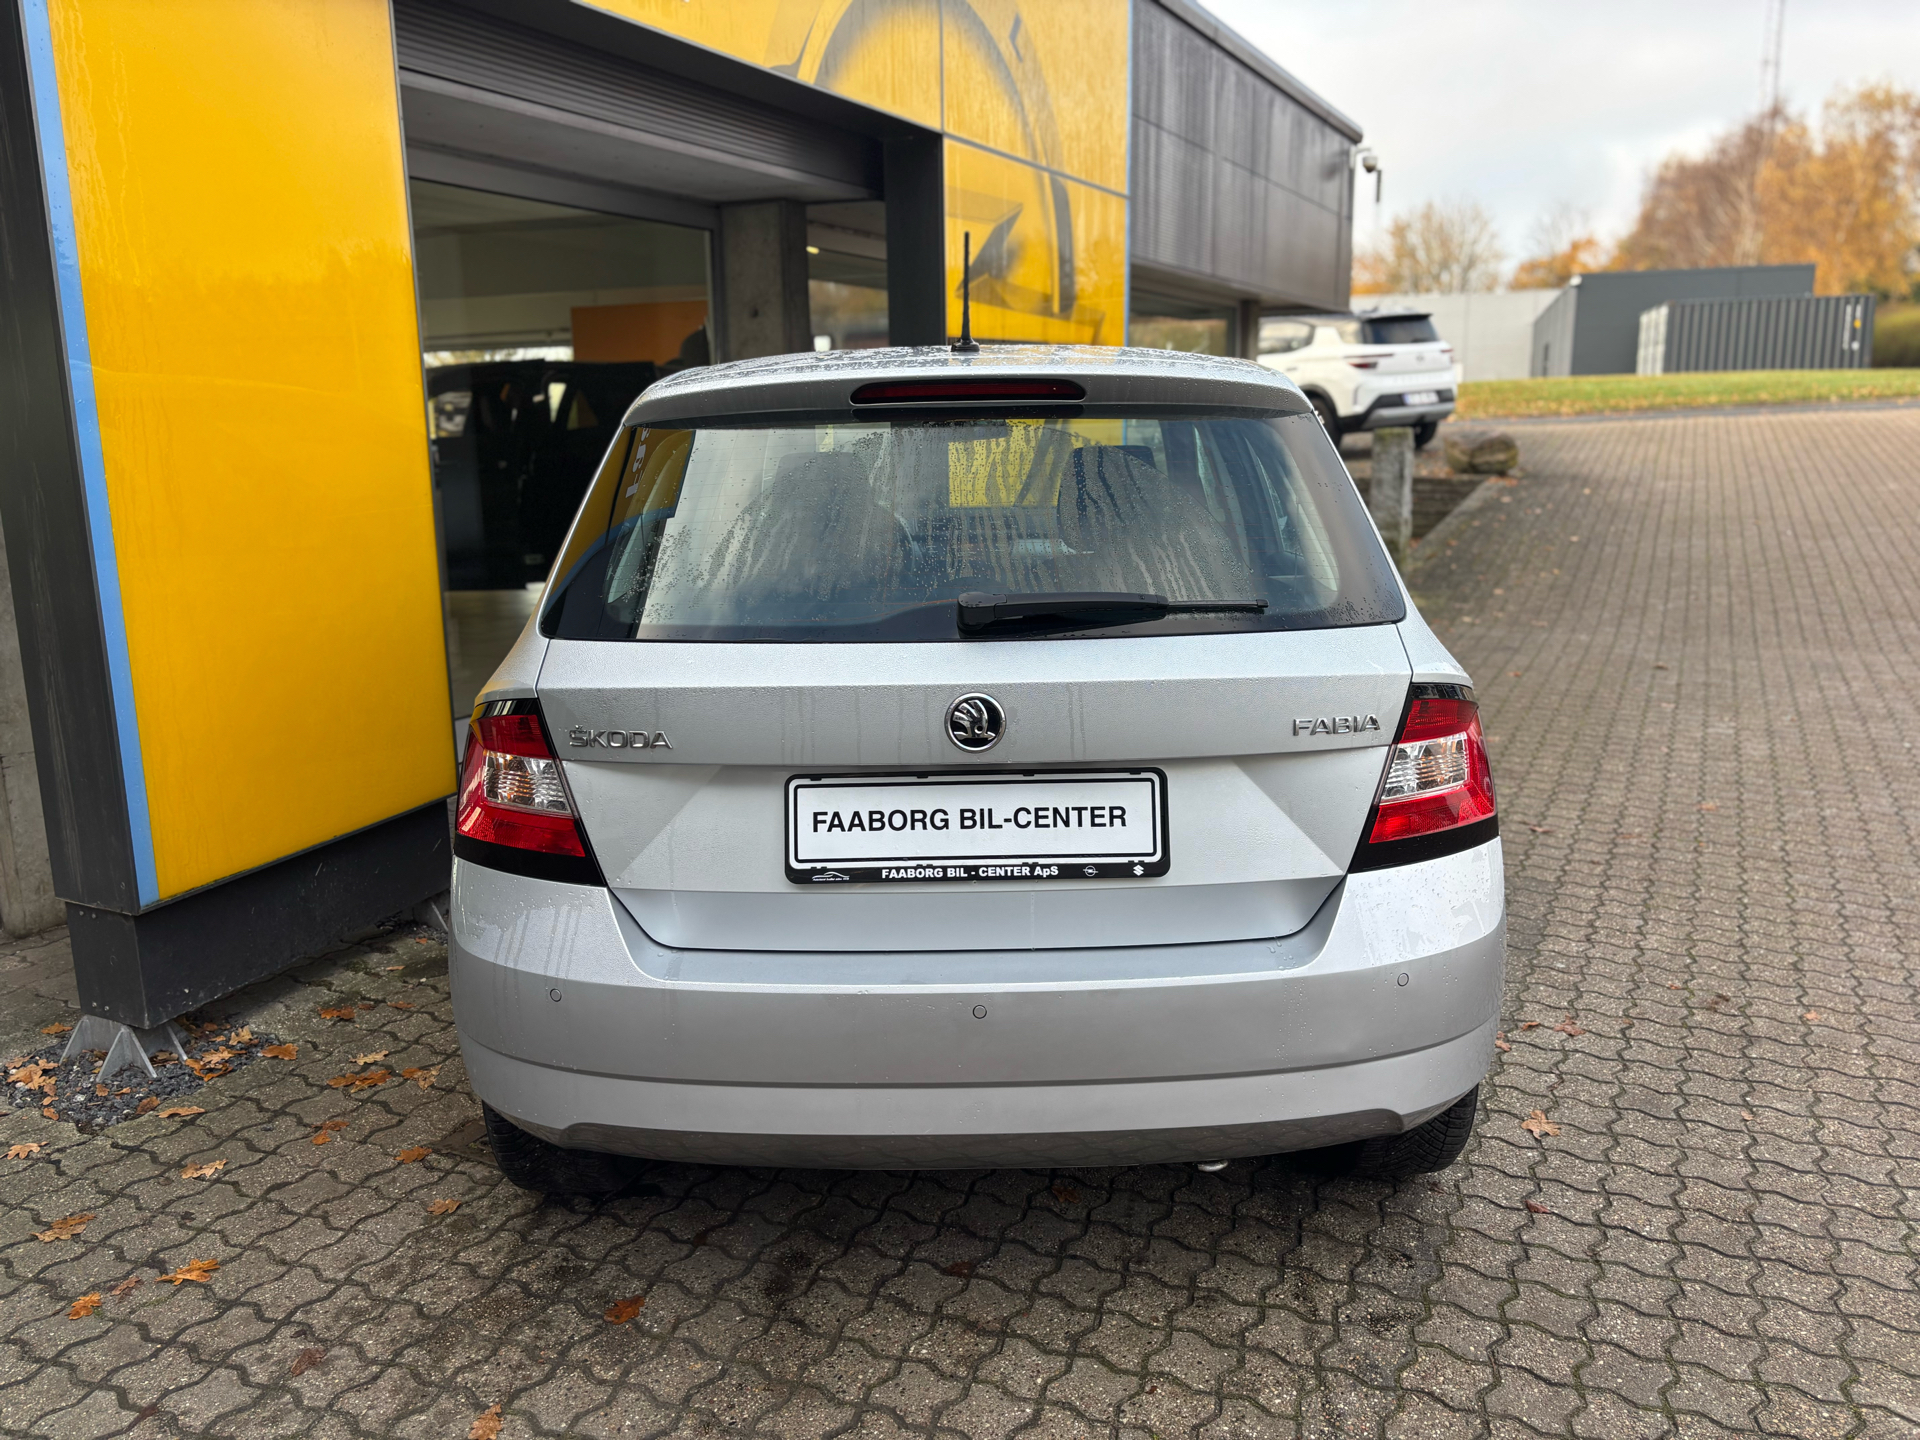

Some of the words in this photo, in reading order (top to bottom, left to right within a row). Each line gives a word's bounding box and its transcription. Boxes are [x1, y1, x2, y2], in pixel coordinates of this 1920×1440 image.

[1292, 713, 1380, 736] FABIA
[569, 725, 673, 749] ŠKODA
[812, 807, 950, 833] FAABORG
[959, 805, 1127, 830] BIL-CENTER
[881, 867, 943, 879] FAABORG
[947, 867, 968, 877] BIL
[978, 866, 1031, 877] CENTER
[1034, 865, 1059, 878] ApS
